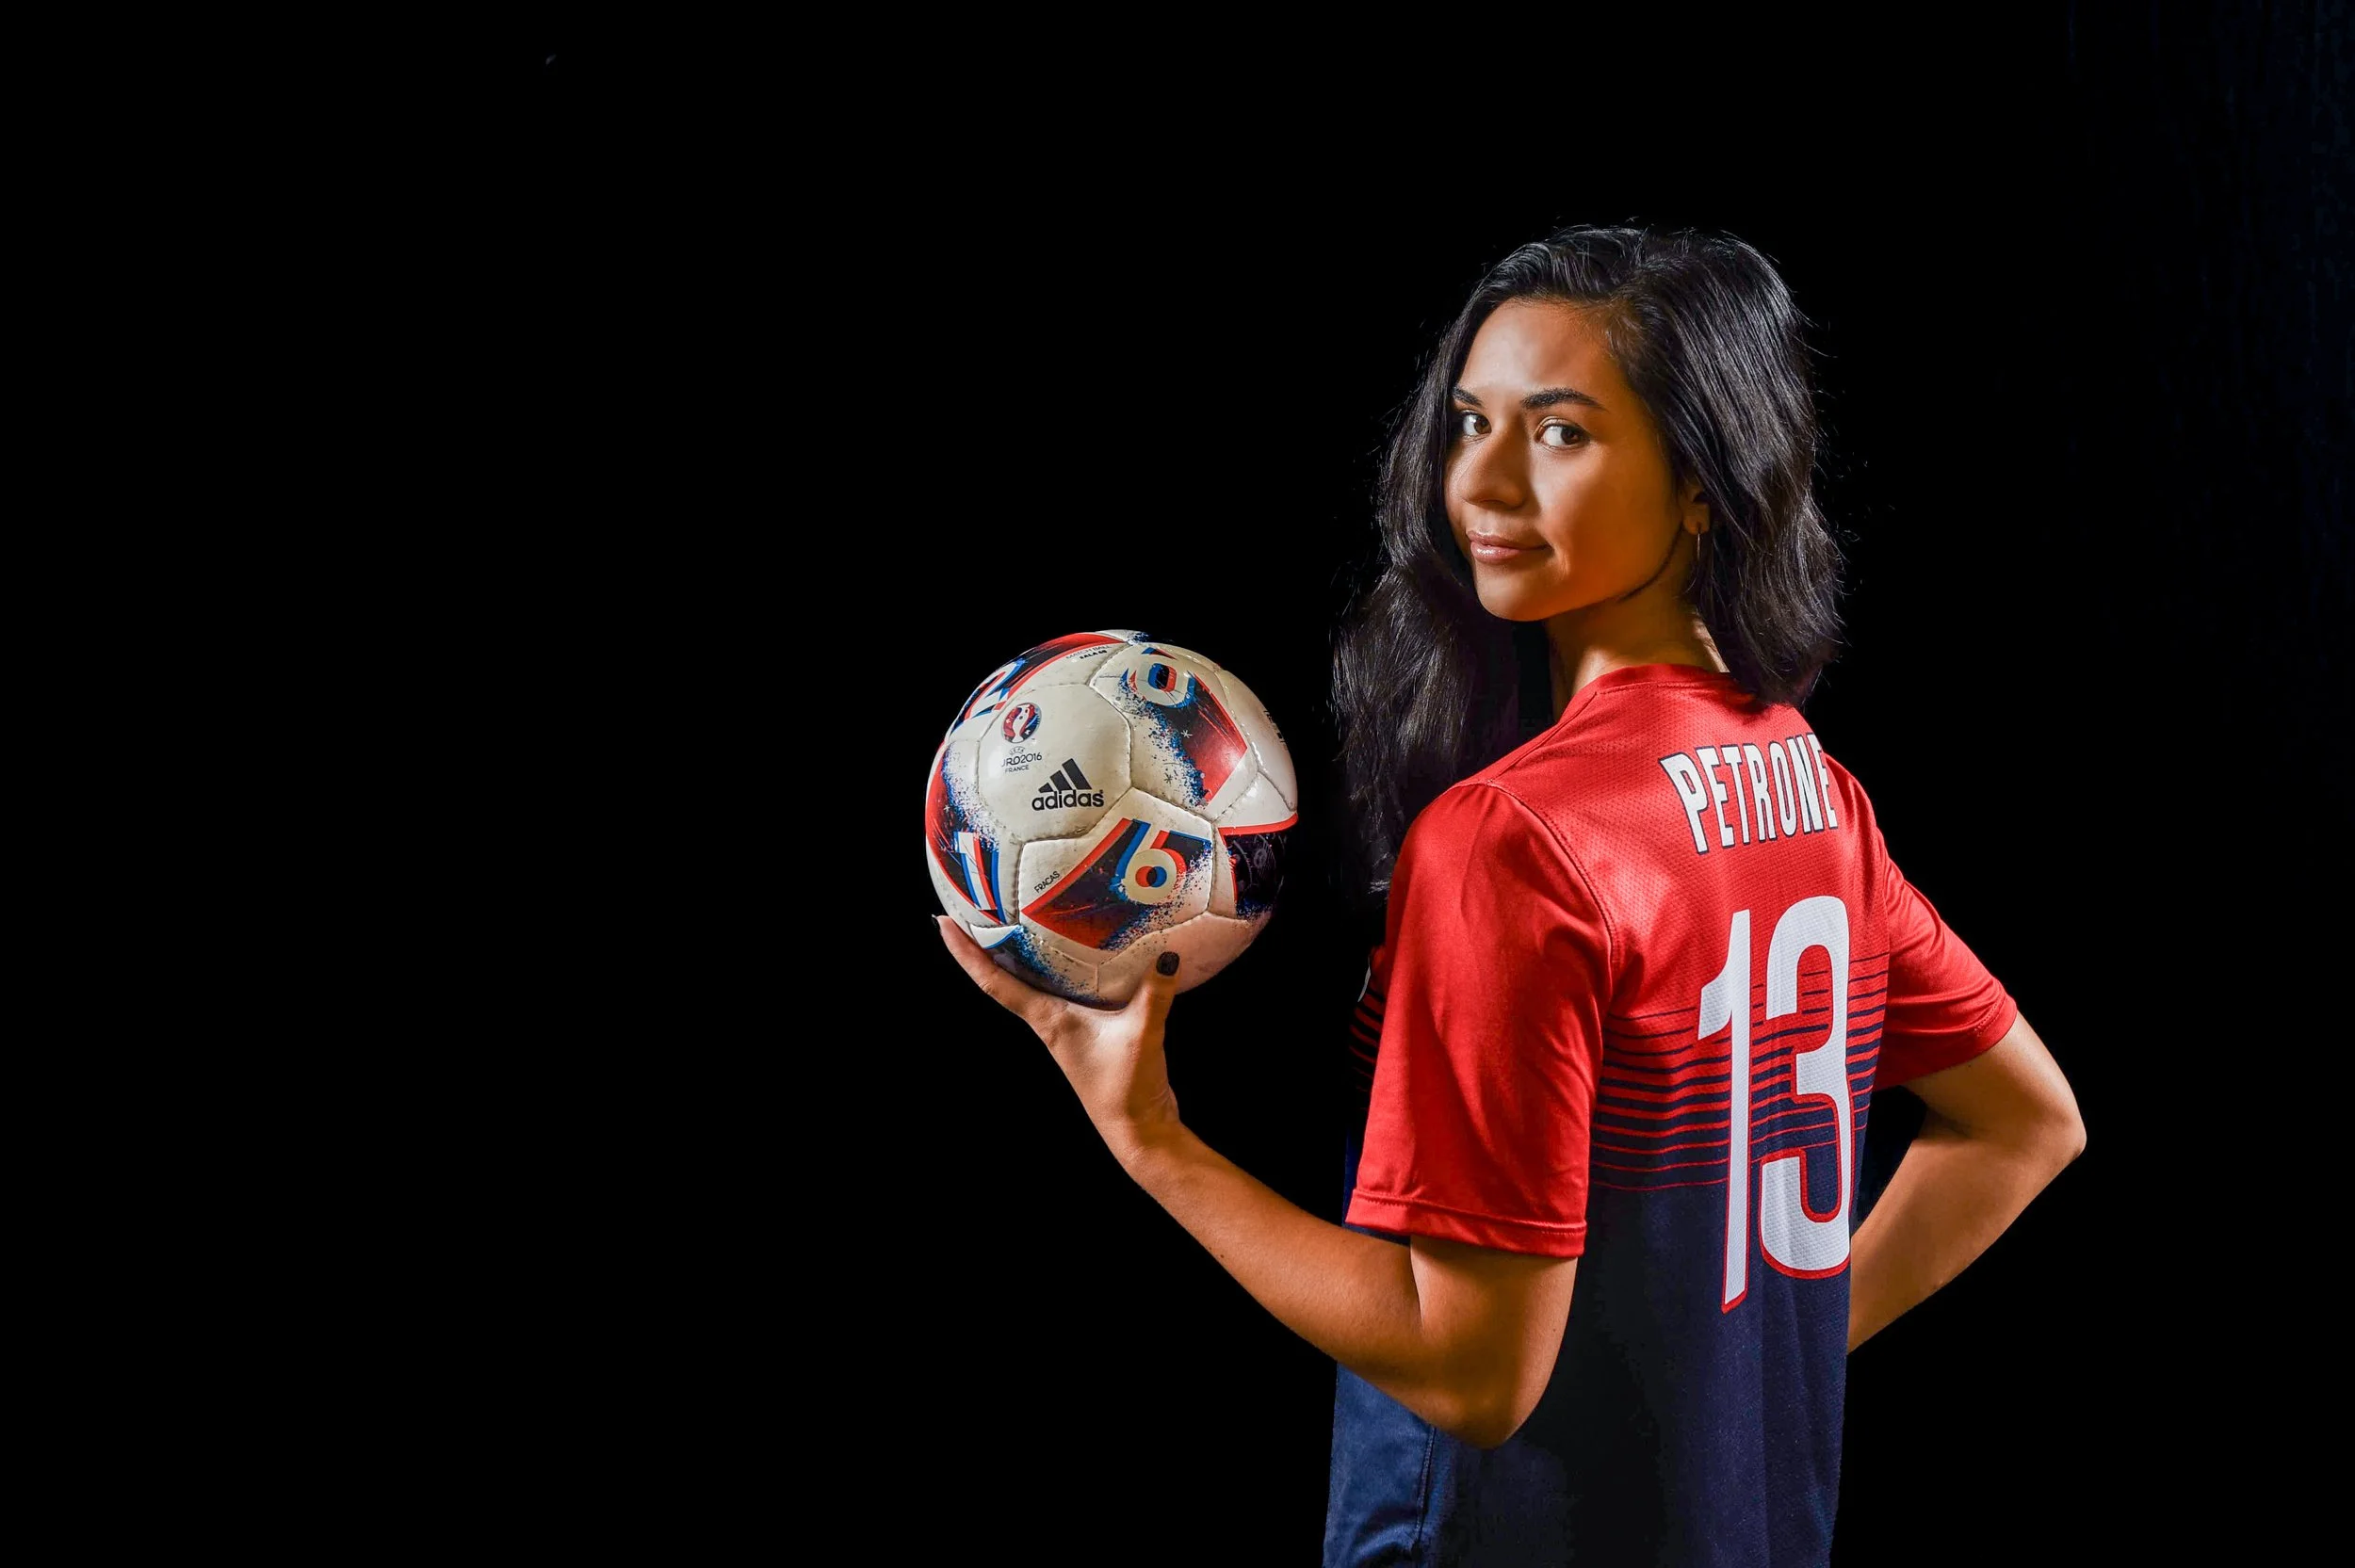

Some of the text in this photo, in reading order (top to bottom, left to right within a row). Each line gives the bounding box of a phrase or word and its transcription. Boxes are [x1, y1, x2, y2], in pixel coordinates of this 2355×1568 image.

[1005, 764, 1030, 773] FRANCE
[1031, 789, 1104, 811] adidas
[1658, 733, 1838, 855] PETRONE
[1034, 870, 1061, 894] FRACAS
[1698, 896, 1852, 1313] 13
